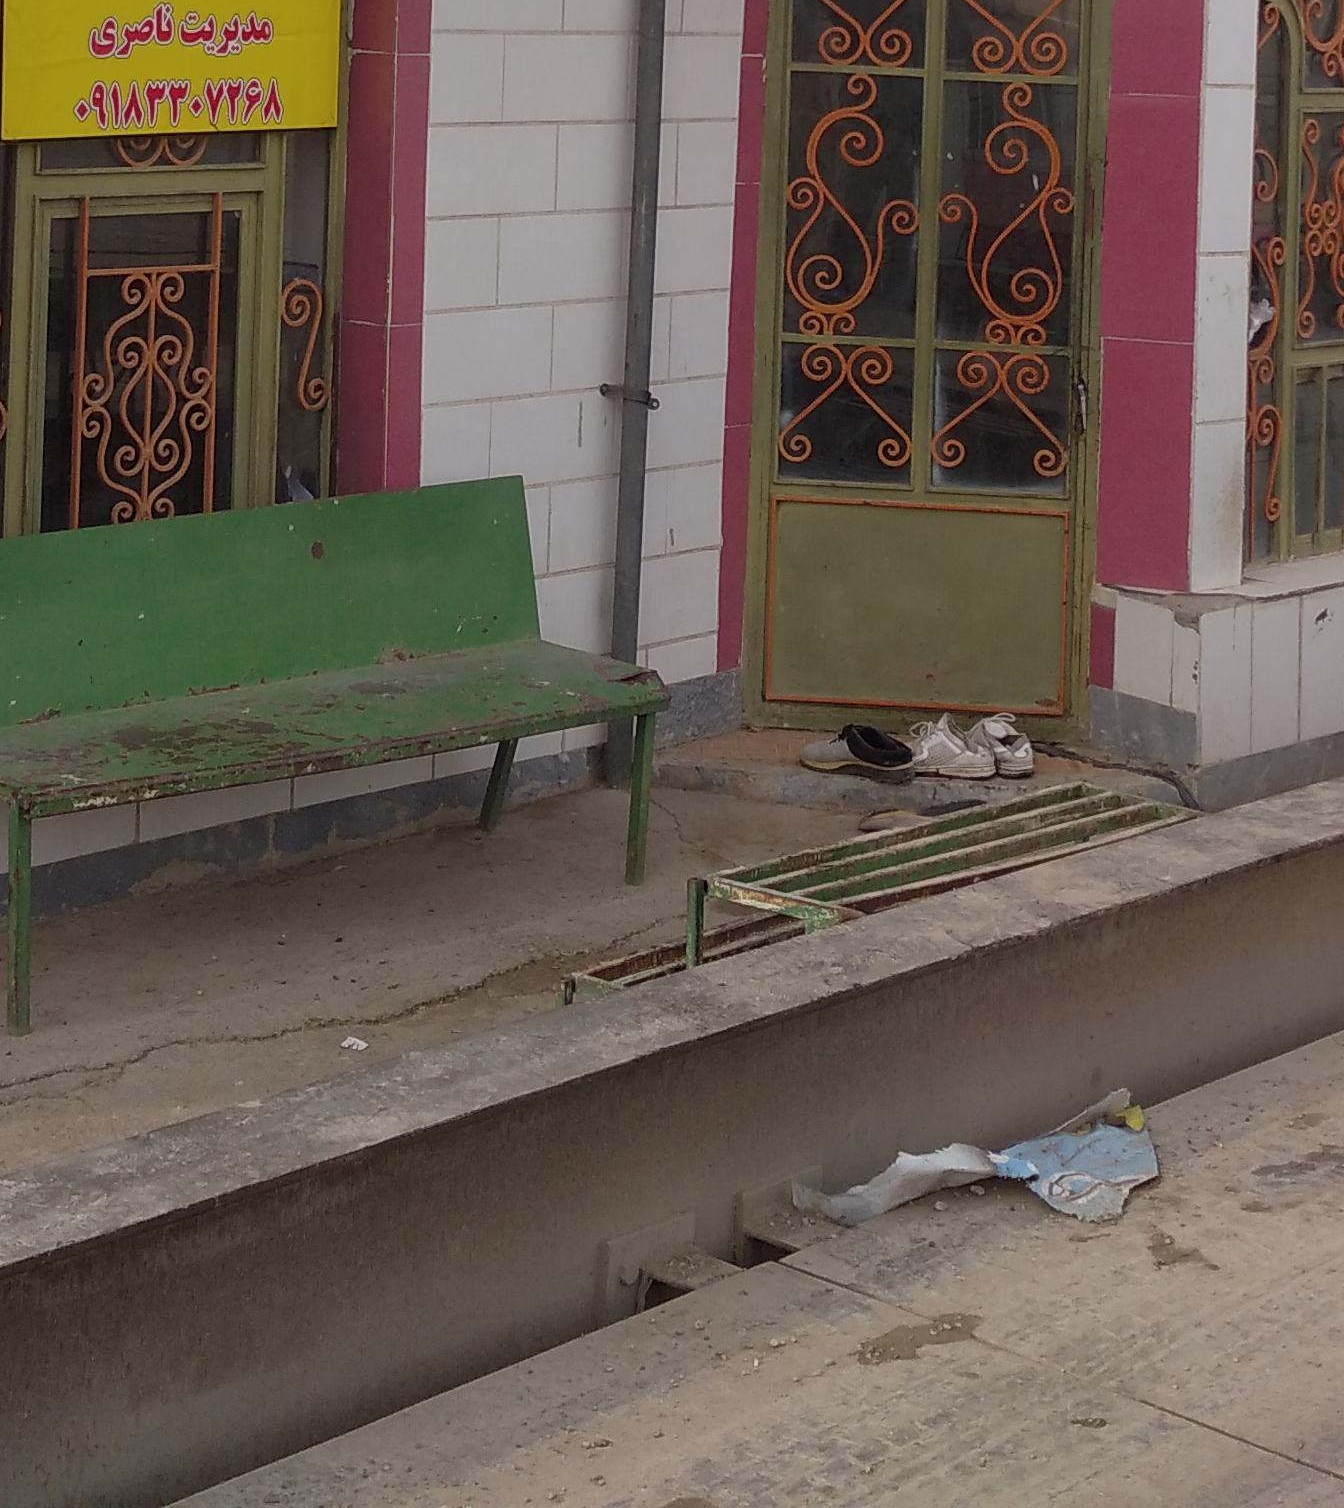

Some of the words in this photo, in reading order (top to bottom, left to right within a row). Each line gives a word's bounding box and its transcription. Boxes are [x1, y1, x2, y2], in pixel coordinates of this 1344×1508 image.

[88, 2, 173, 58] ناصری
[178, 9, 273, 56] مدیریت
[73, 77, 284, 129] ۰۹۱۸۳۳۰۷۲۶۸
